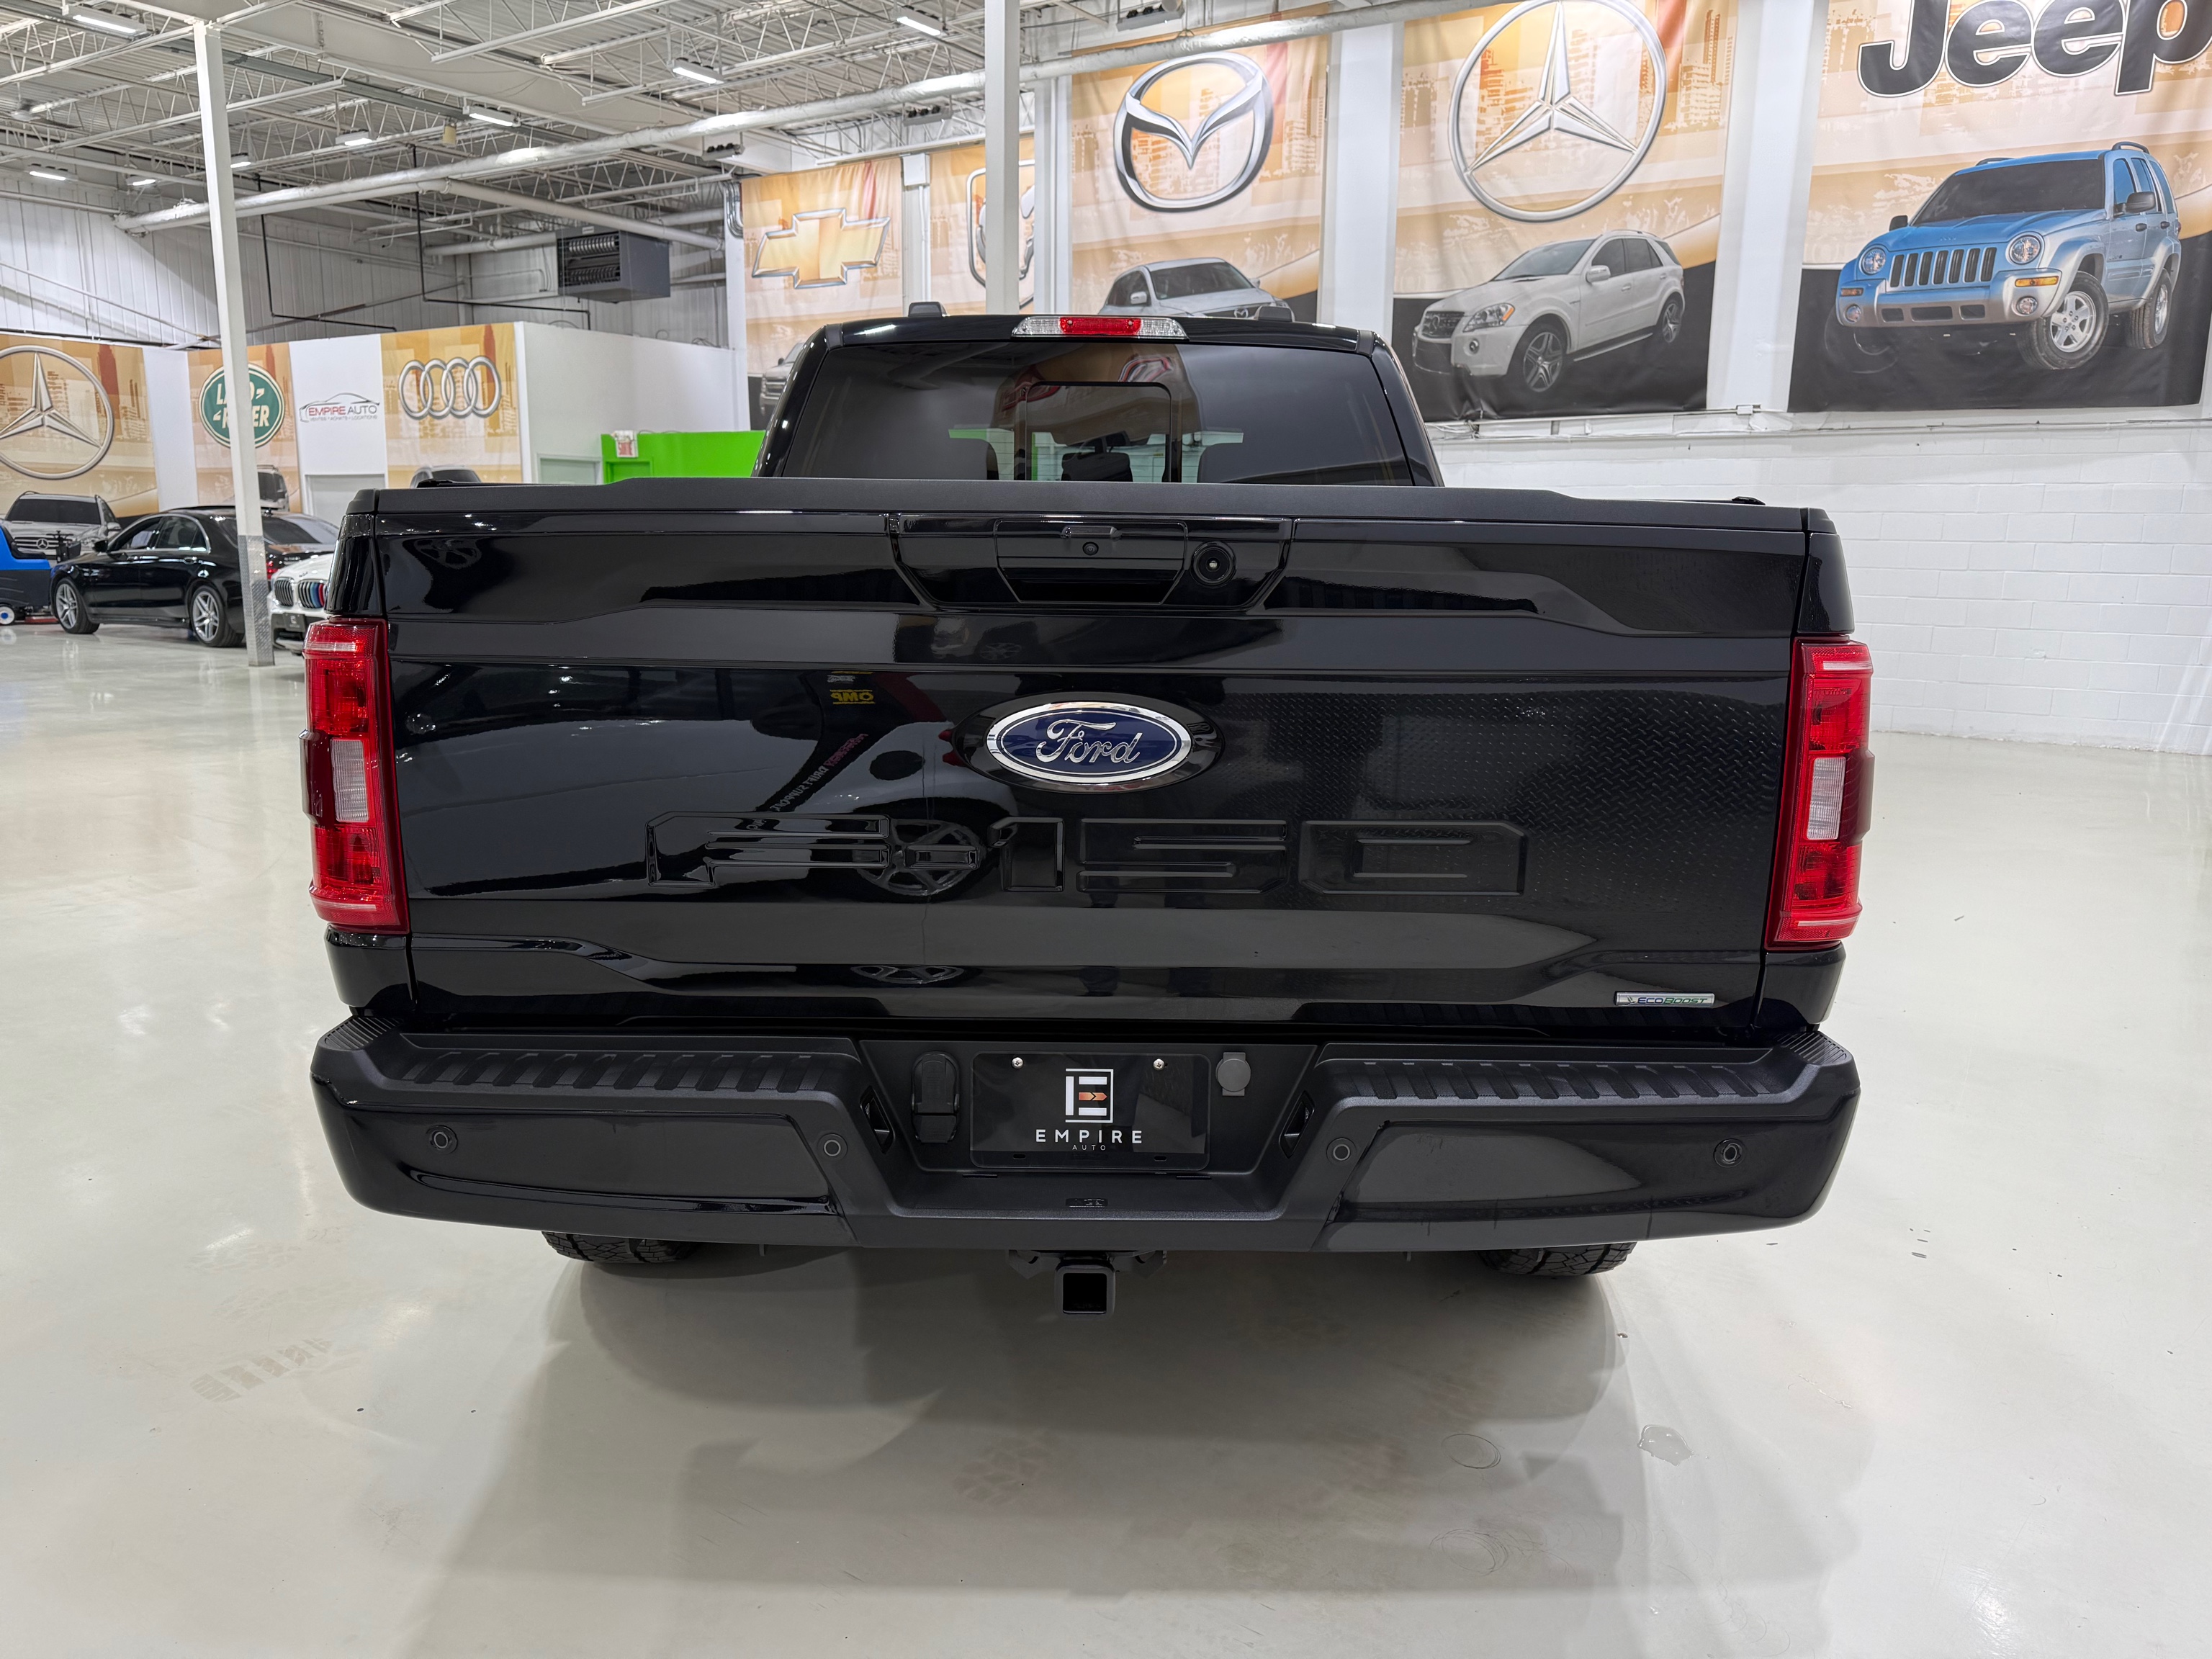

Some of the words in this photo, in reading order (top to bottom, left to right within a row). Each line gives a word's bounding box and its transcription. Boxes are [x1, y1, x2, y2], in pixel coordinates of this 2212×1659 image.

[1858, 0, 2212, 97] Jeep
[308, 406, 346, 415] EMPIRE
[347, 405, 377, 415] AUTO
[1035, 719, 1143, 764] Ford
[645, 811, 1528, 896] F-150
[1035, 1128, 1143, 1144] EMPIRE
